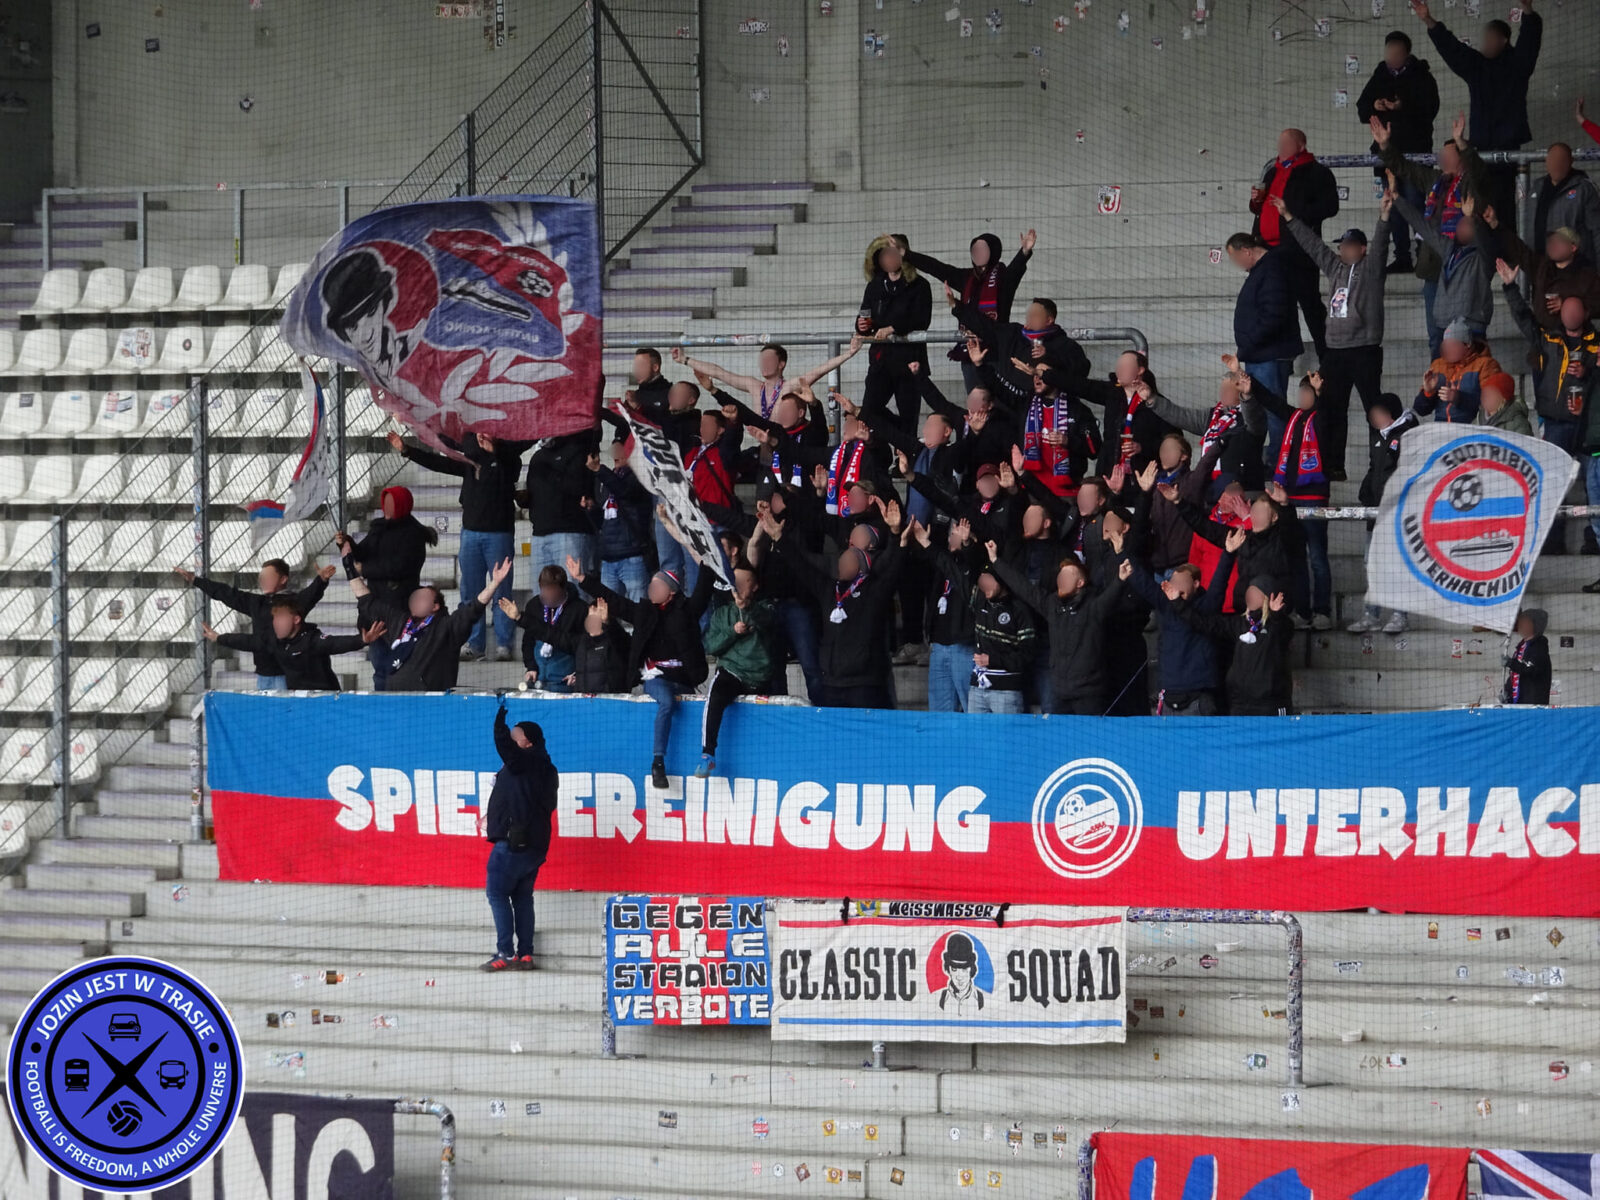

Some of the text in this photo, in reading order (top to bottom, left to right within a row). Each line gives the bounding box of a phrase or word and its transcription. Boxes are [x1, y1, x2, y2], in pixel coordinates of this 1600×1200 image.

[327, 764, 990, 854] SPIEEREINIGUNG
[612, 902, 765, 930] GEGEN
[614, 933, 765, 958] ALLE
[614, 962, 768, 989] STADION
[780, 945, 1121, 1009] CLASSIC SQUAD
[613, 994, 770, 1019] VERBOTE
